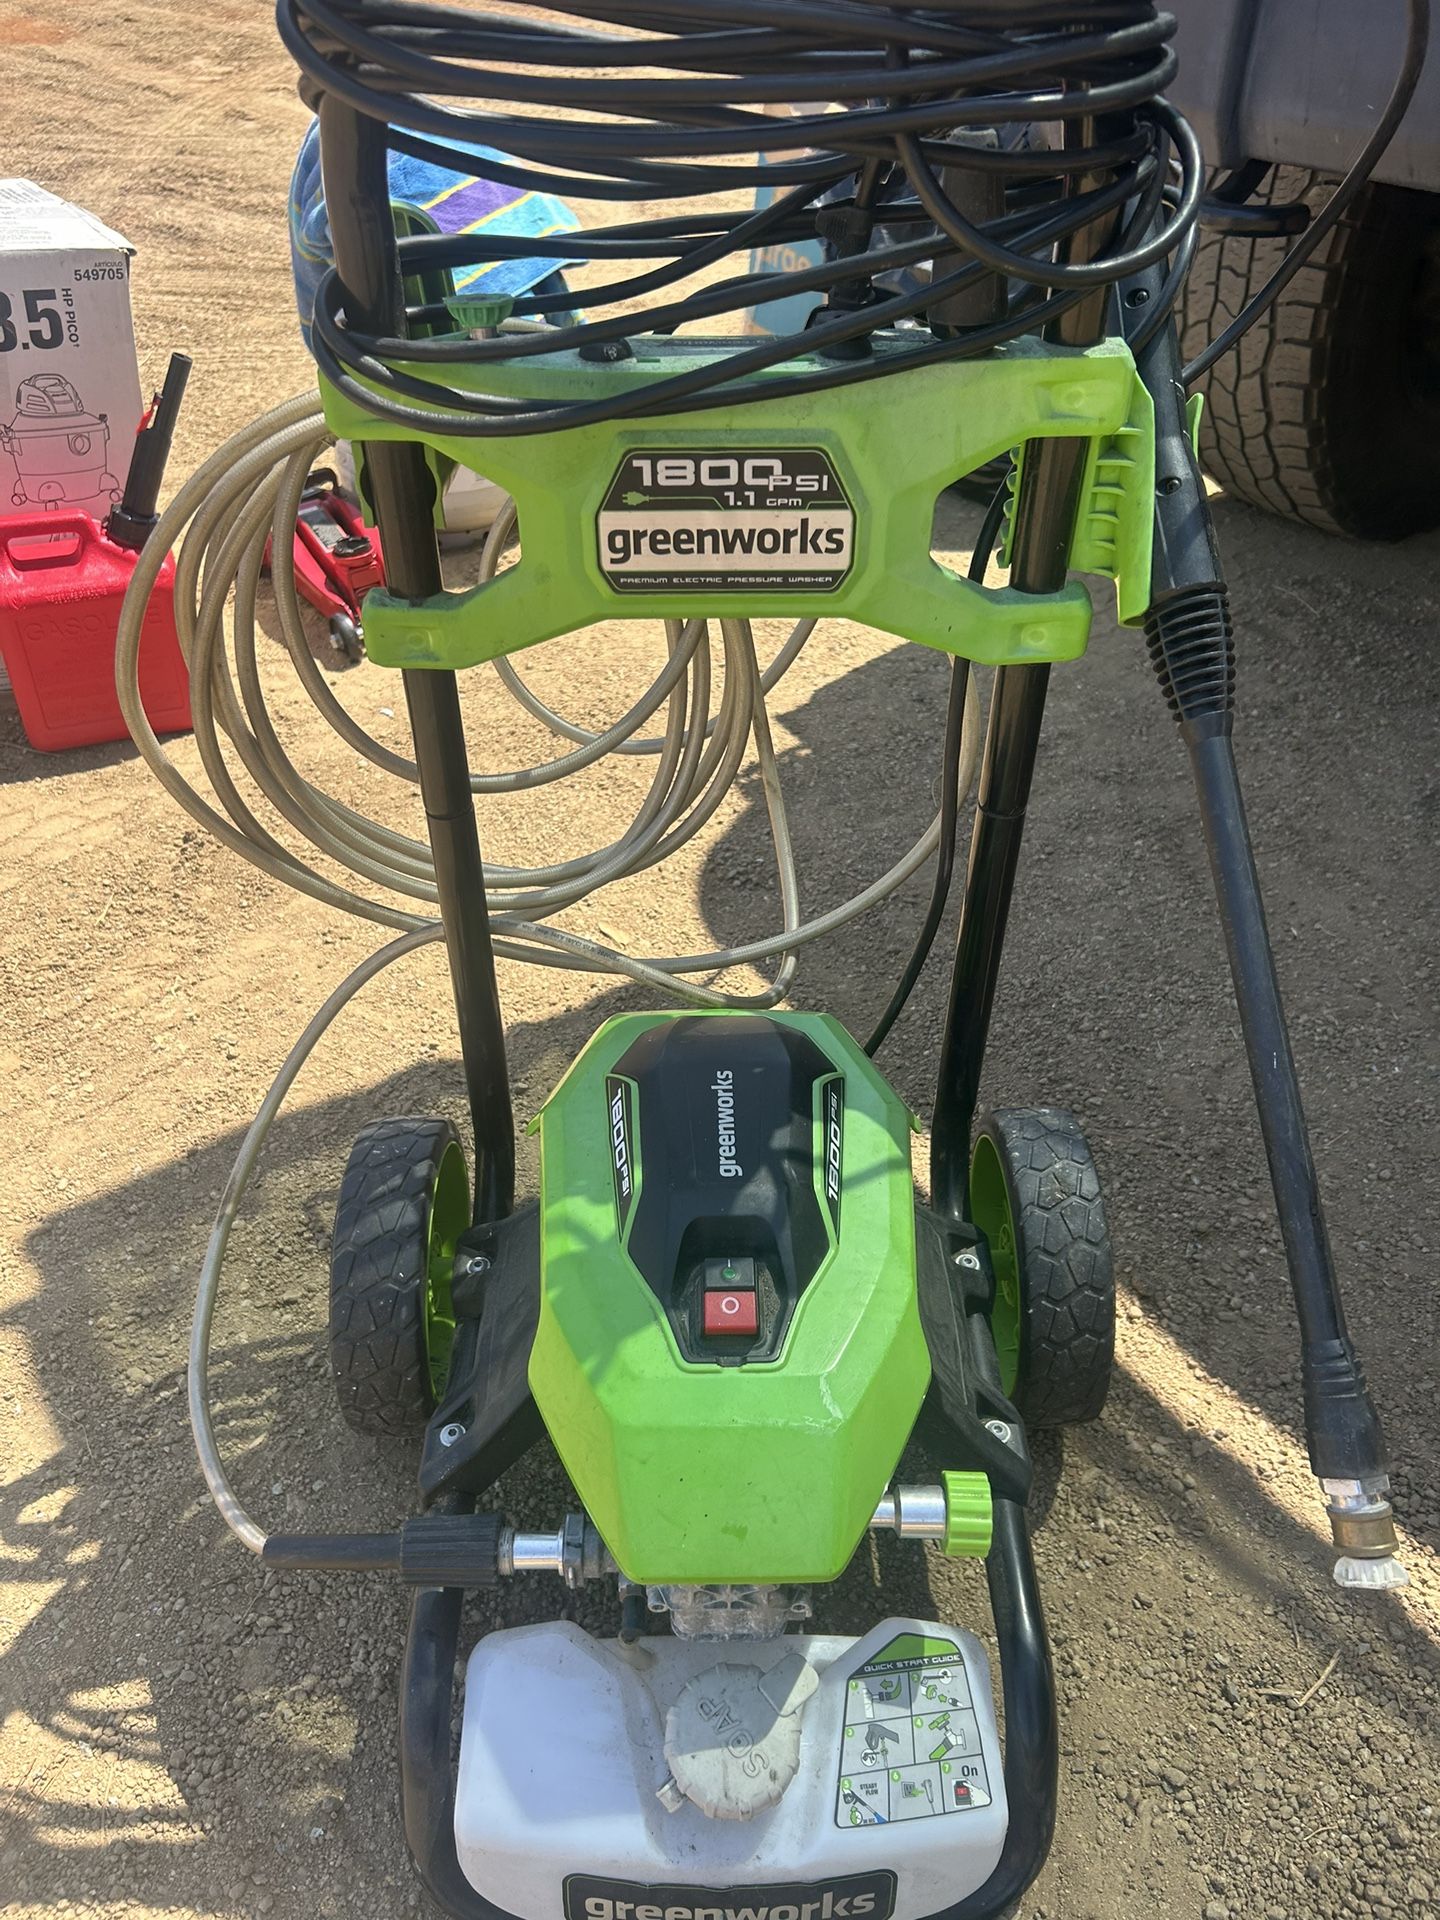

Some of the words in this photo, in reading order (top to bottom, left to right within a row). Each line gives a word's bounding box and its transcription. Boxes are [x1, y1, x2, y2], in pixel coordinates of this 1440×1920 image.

[74, 268, 124, 281] 549705
[61, 288, 74, 307] HP
[724, 491, 755, 506] 1.1
[607, 517, 845, 565] greenworks
[24, 606, 164, 641] GASOLE
[711, 1070, 743, 1178] greenworks
[864, 1661, 894, 1673] QUICK
[896, 1657, 929, 1669] START
[931, 1654, 961, 1664] GUIDE
[697, 1697, 770, 1779] SOAP
[961, 1765, 979, 1777] On
